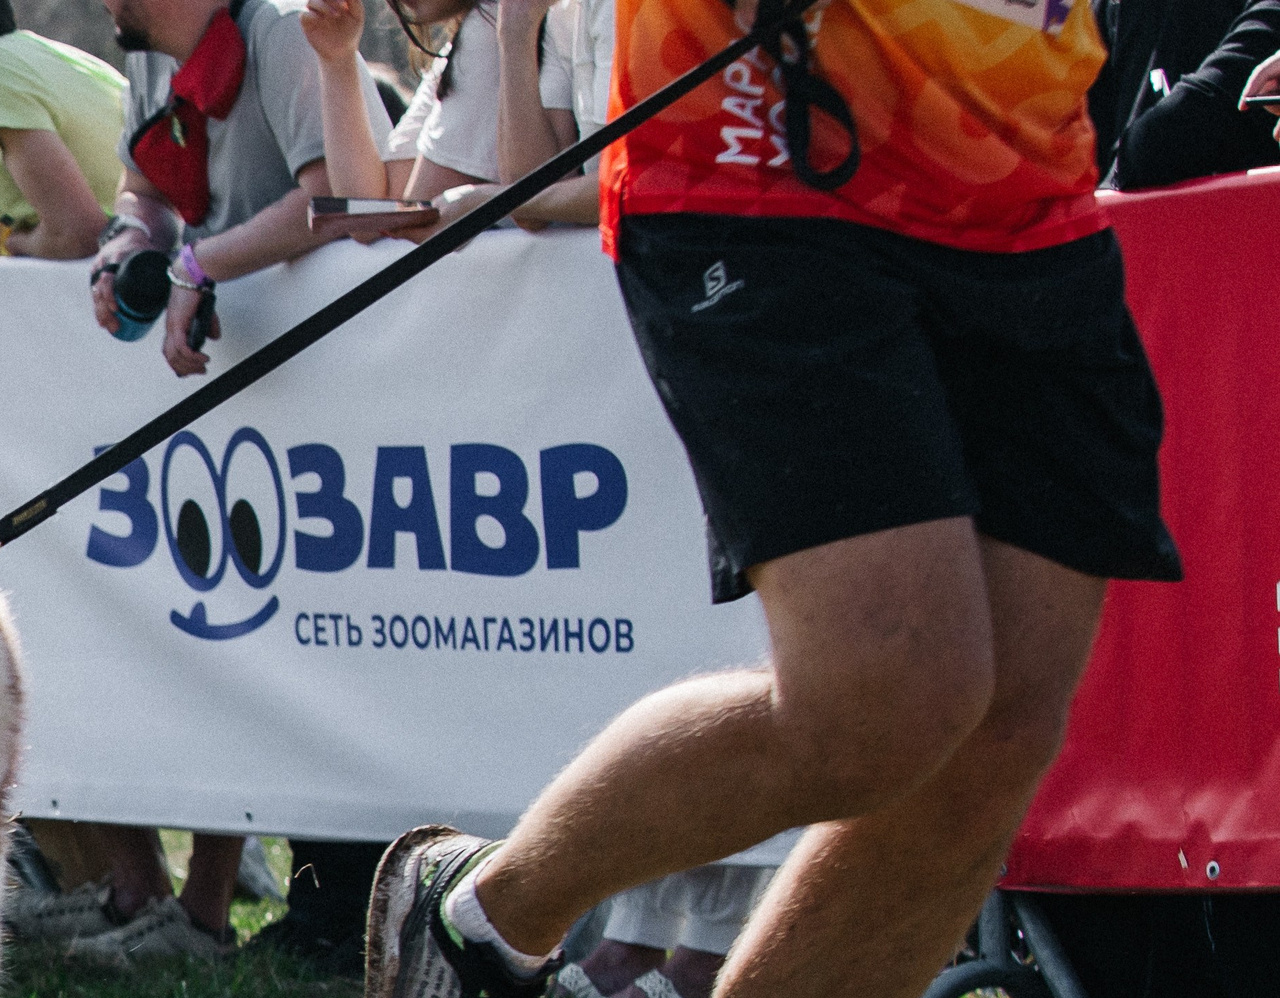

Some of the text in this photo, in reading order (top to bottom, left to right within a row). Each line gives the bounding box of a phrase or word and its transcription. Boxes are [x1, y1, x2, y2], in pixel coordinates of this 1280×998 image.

[86, 426, 628, 592] ЗООЗАВР
[294, 612, 636, 654] СЕТЬ ЗООМАГАЗИНОВ
